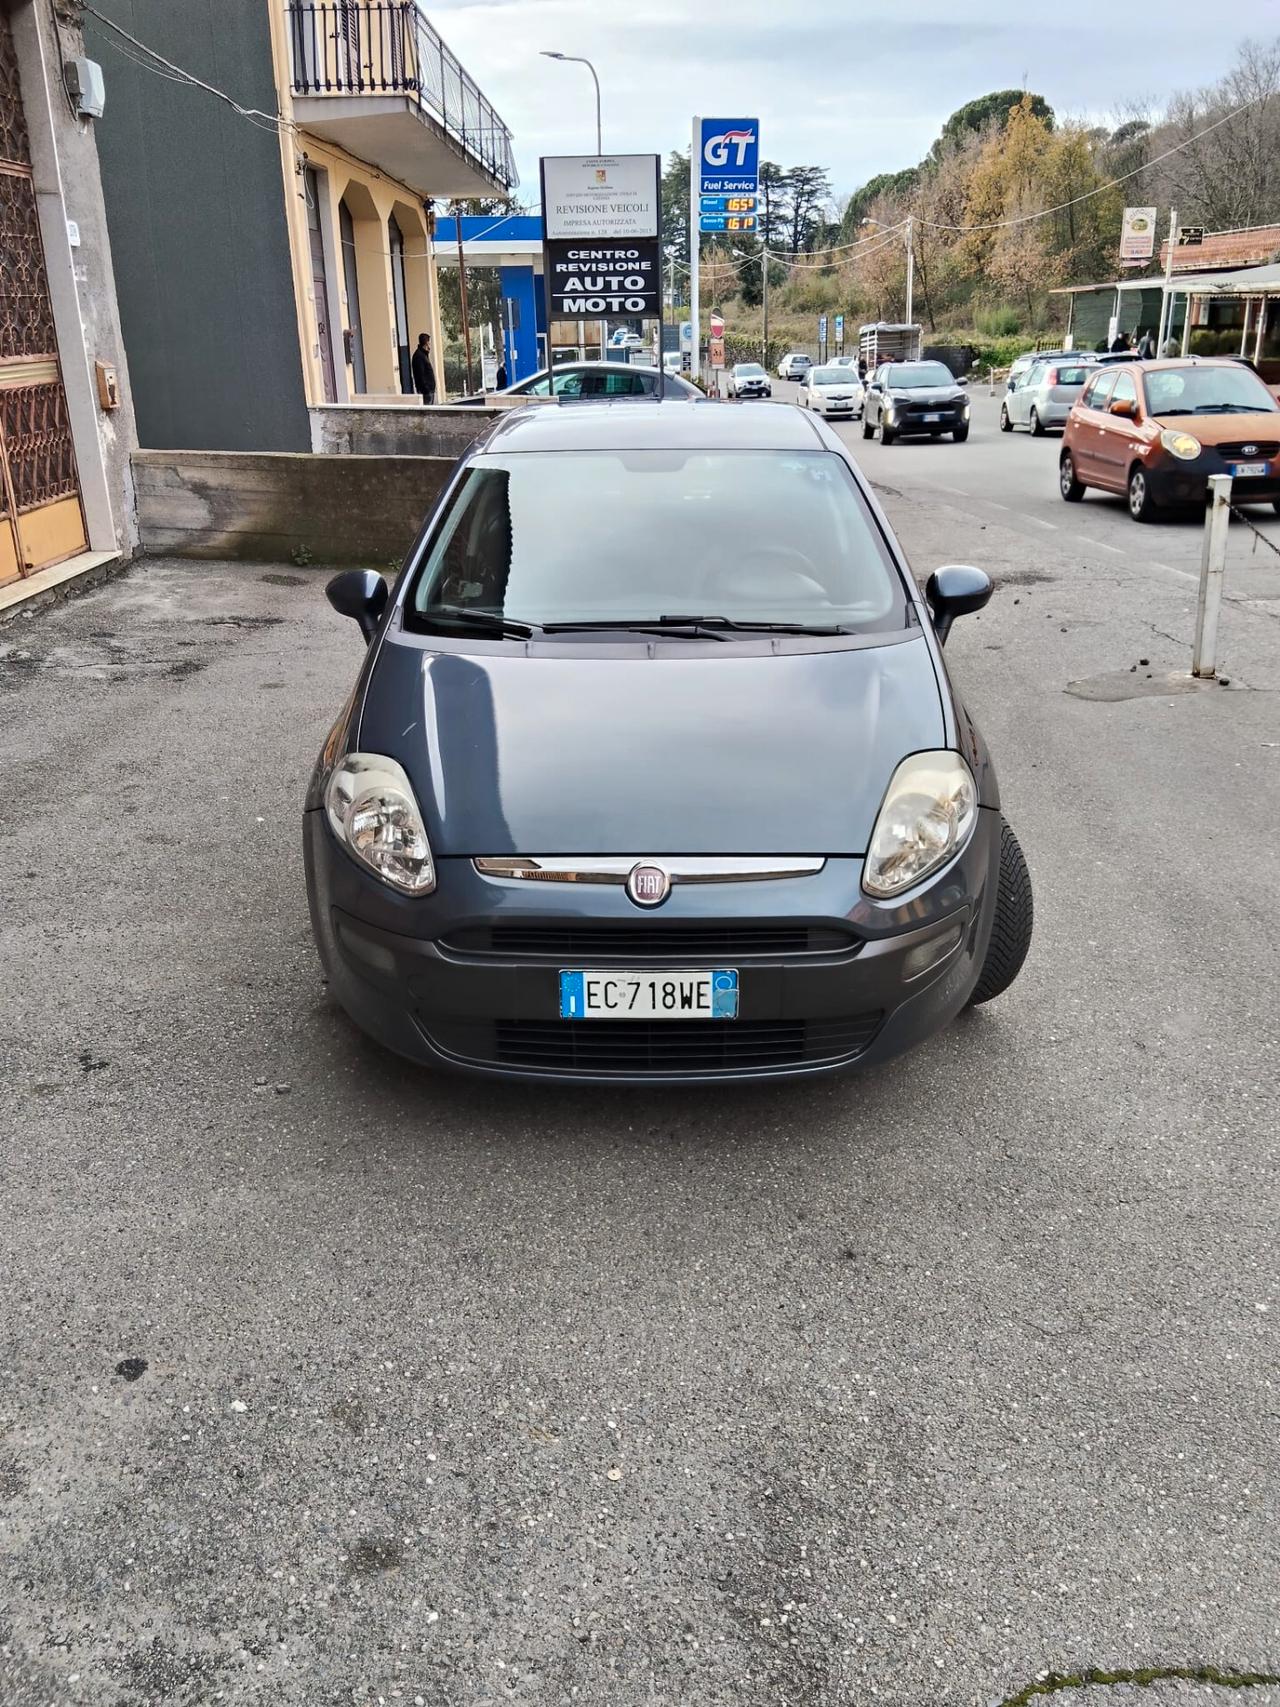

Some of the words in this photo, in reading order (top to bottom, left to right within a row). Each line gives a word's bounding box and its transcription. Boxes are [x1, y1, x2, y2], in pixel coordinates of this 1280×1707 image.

[703, 133, 756, 166] GT
[704, 181, 721, 190] Fuel
[723, 181, 755, 190] Service
[556, 205, 608, 214] REVISIONE
[610, 203, 649, 213] VEICOLI
[567, 250, 640, 259] CENTRO
[556, 261, 652, 272] REVISIONE
[564, 276, 645, 292] AUTO
[563, 297, 646, 313] MOTO
[637, 875, 662, 894] FIAT
[586, 981, 711, 1010] EC718WE
